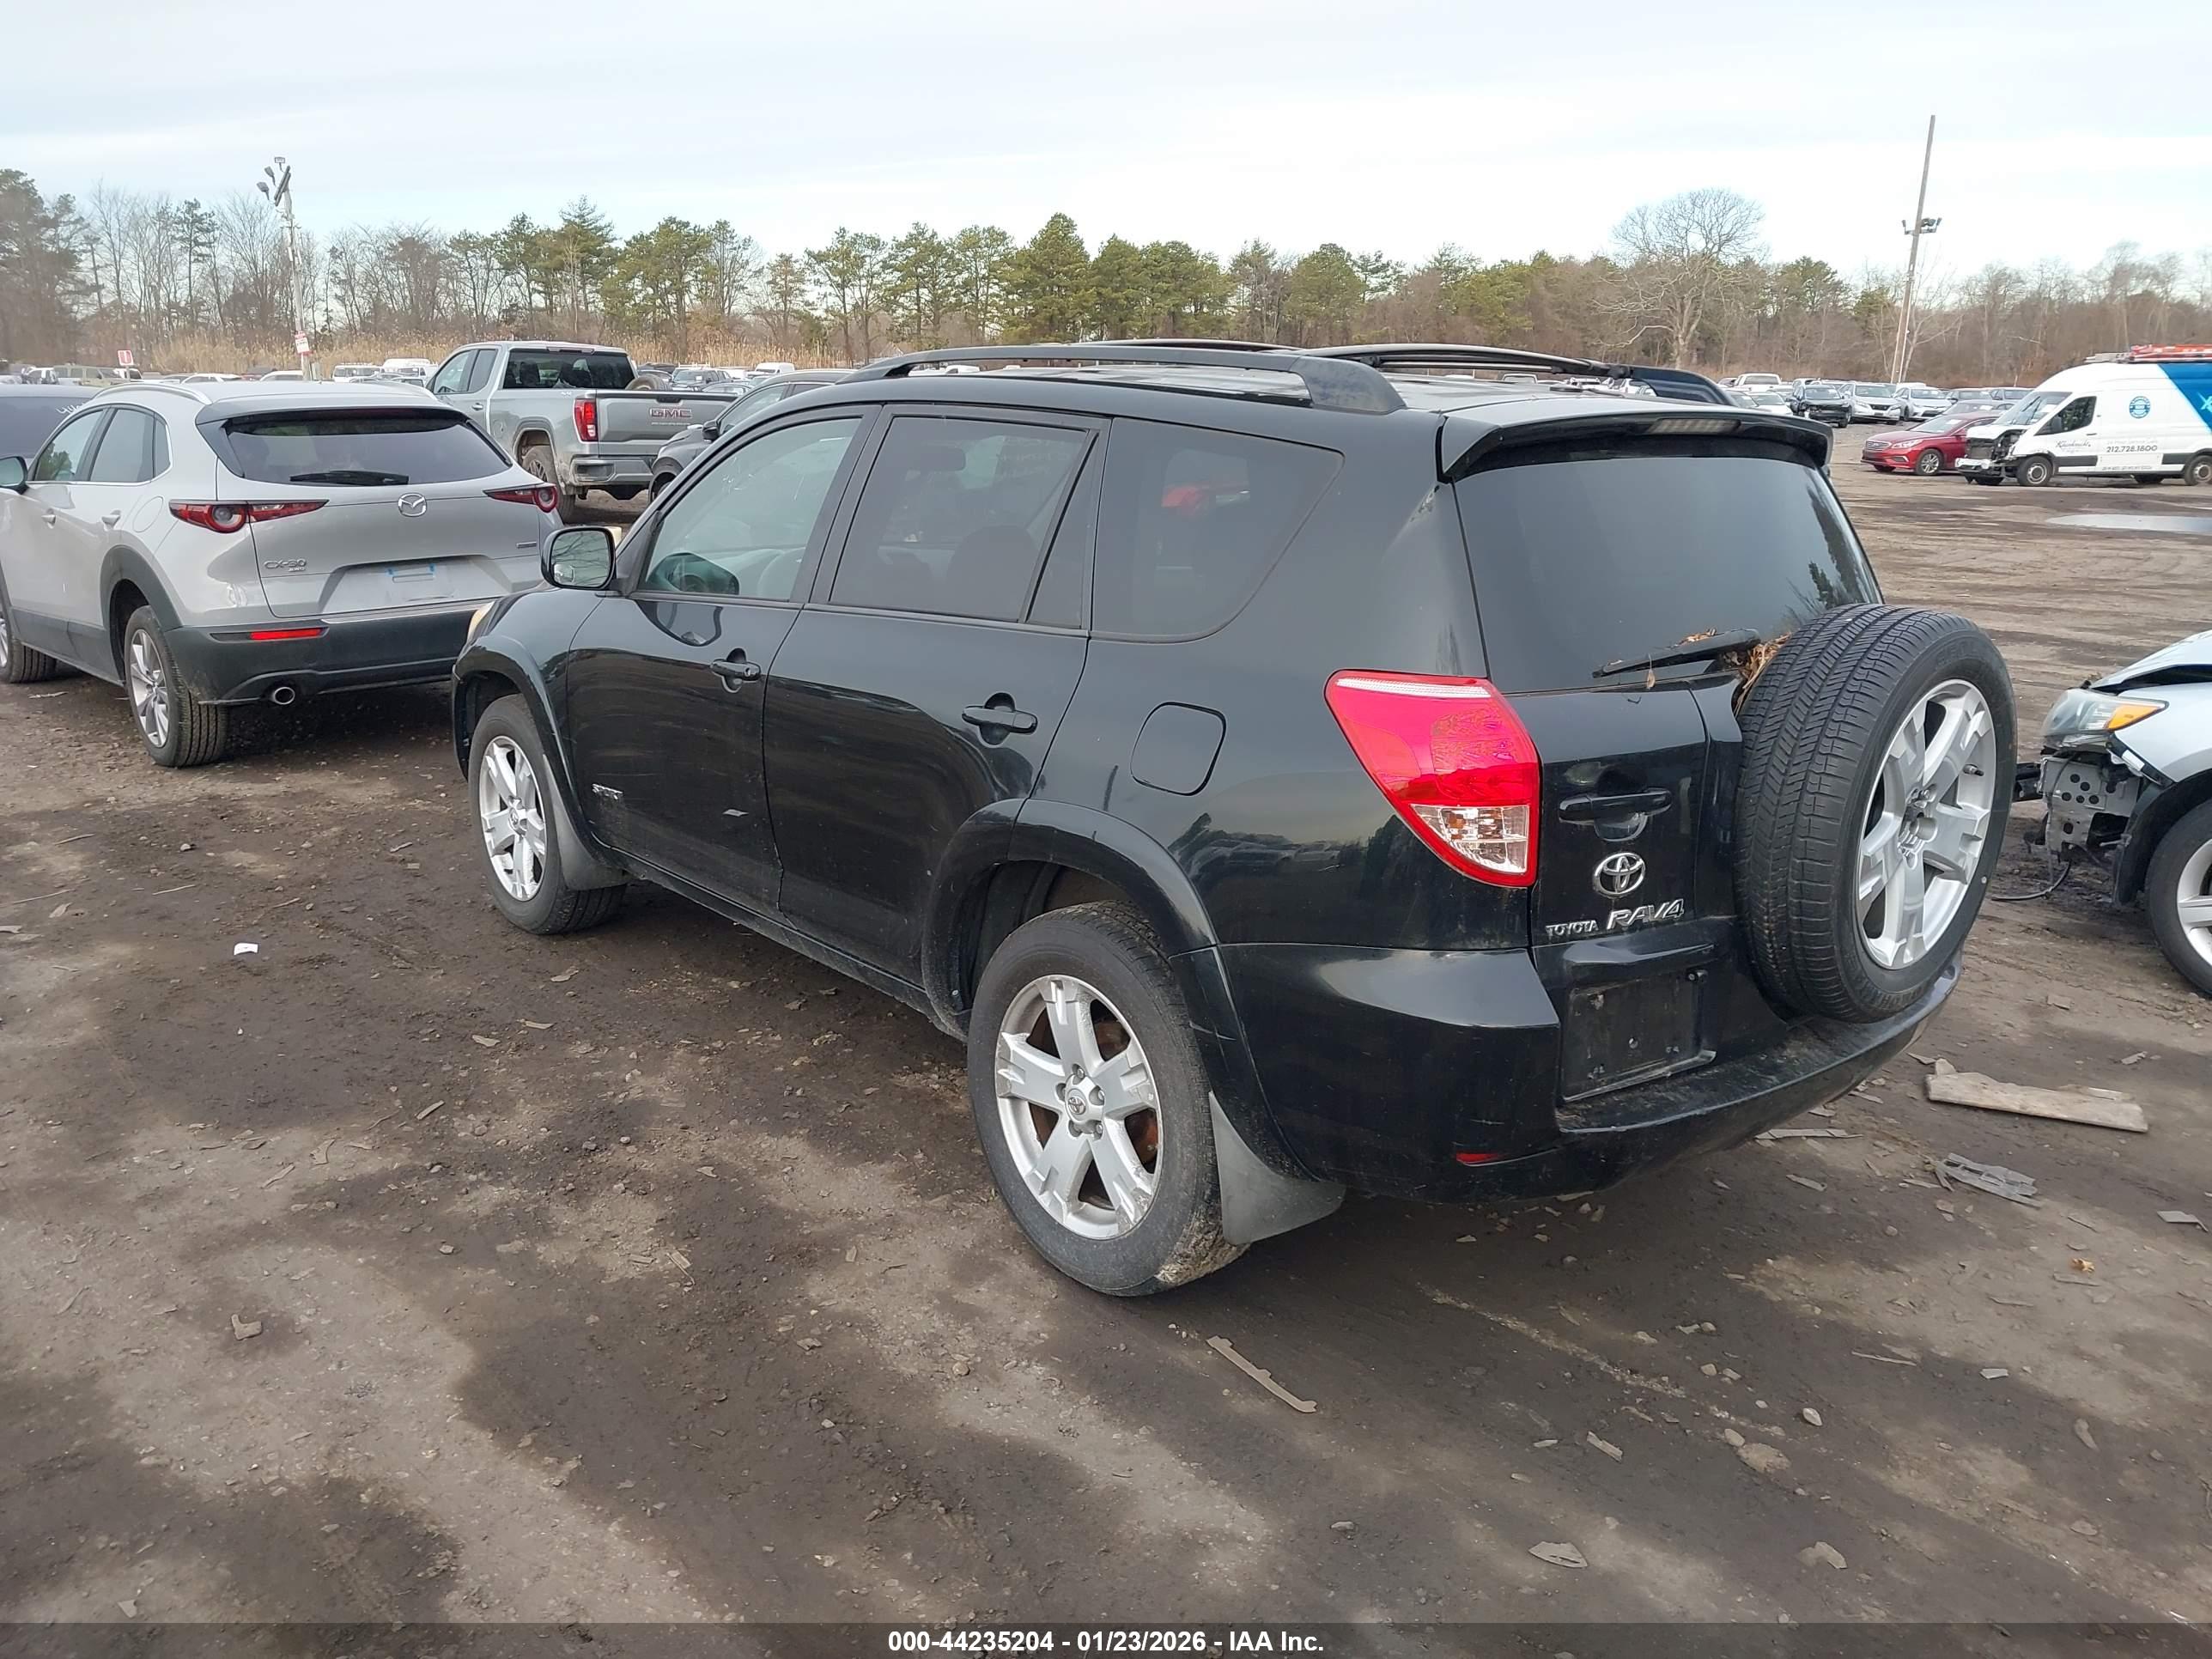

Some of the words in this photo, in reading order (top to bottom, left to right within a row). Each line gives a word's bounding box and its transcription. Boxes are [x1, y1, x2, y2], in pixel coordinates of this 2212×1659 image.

[649, 408, 692, 418] GMC
[2106, 445, 2158, 453] 212.728.1800
[263, 558, 307, 569] CX-30
[1546, 920, 1599, 938] TOYOTA
[1607, 898, 1685, 932] RAV4
